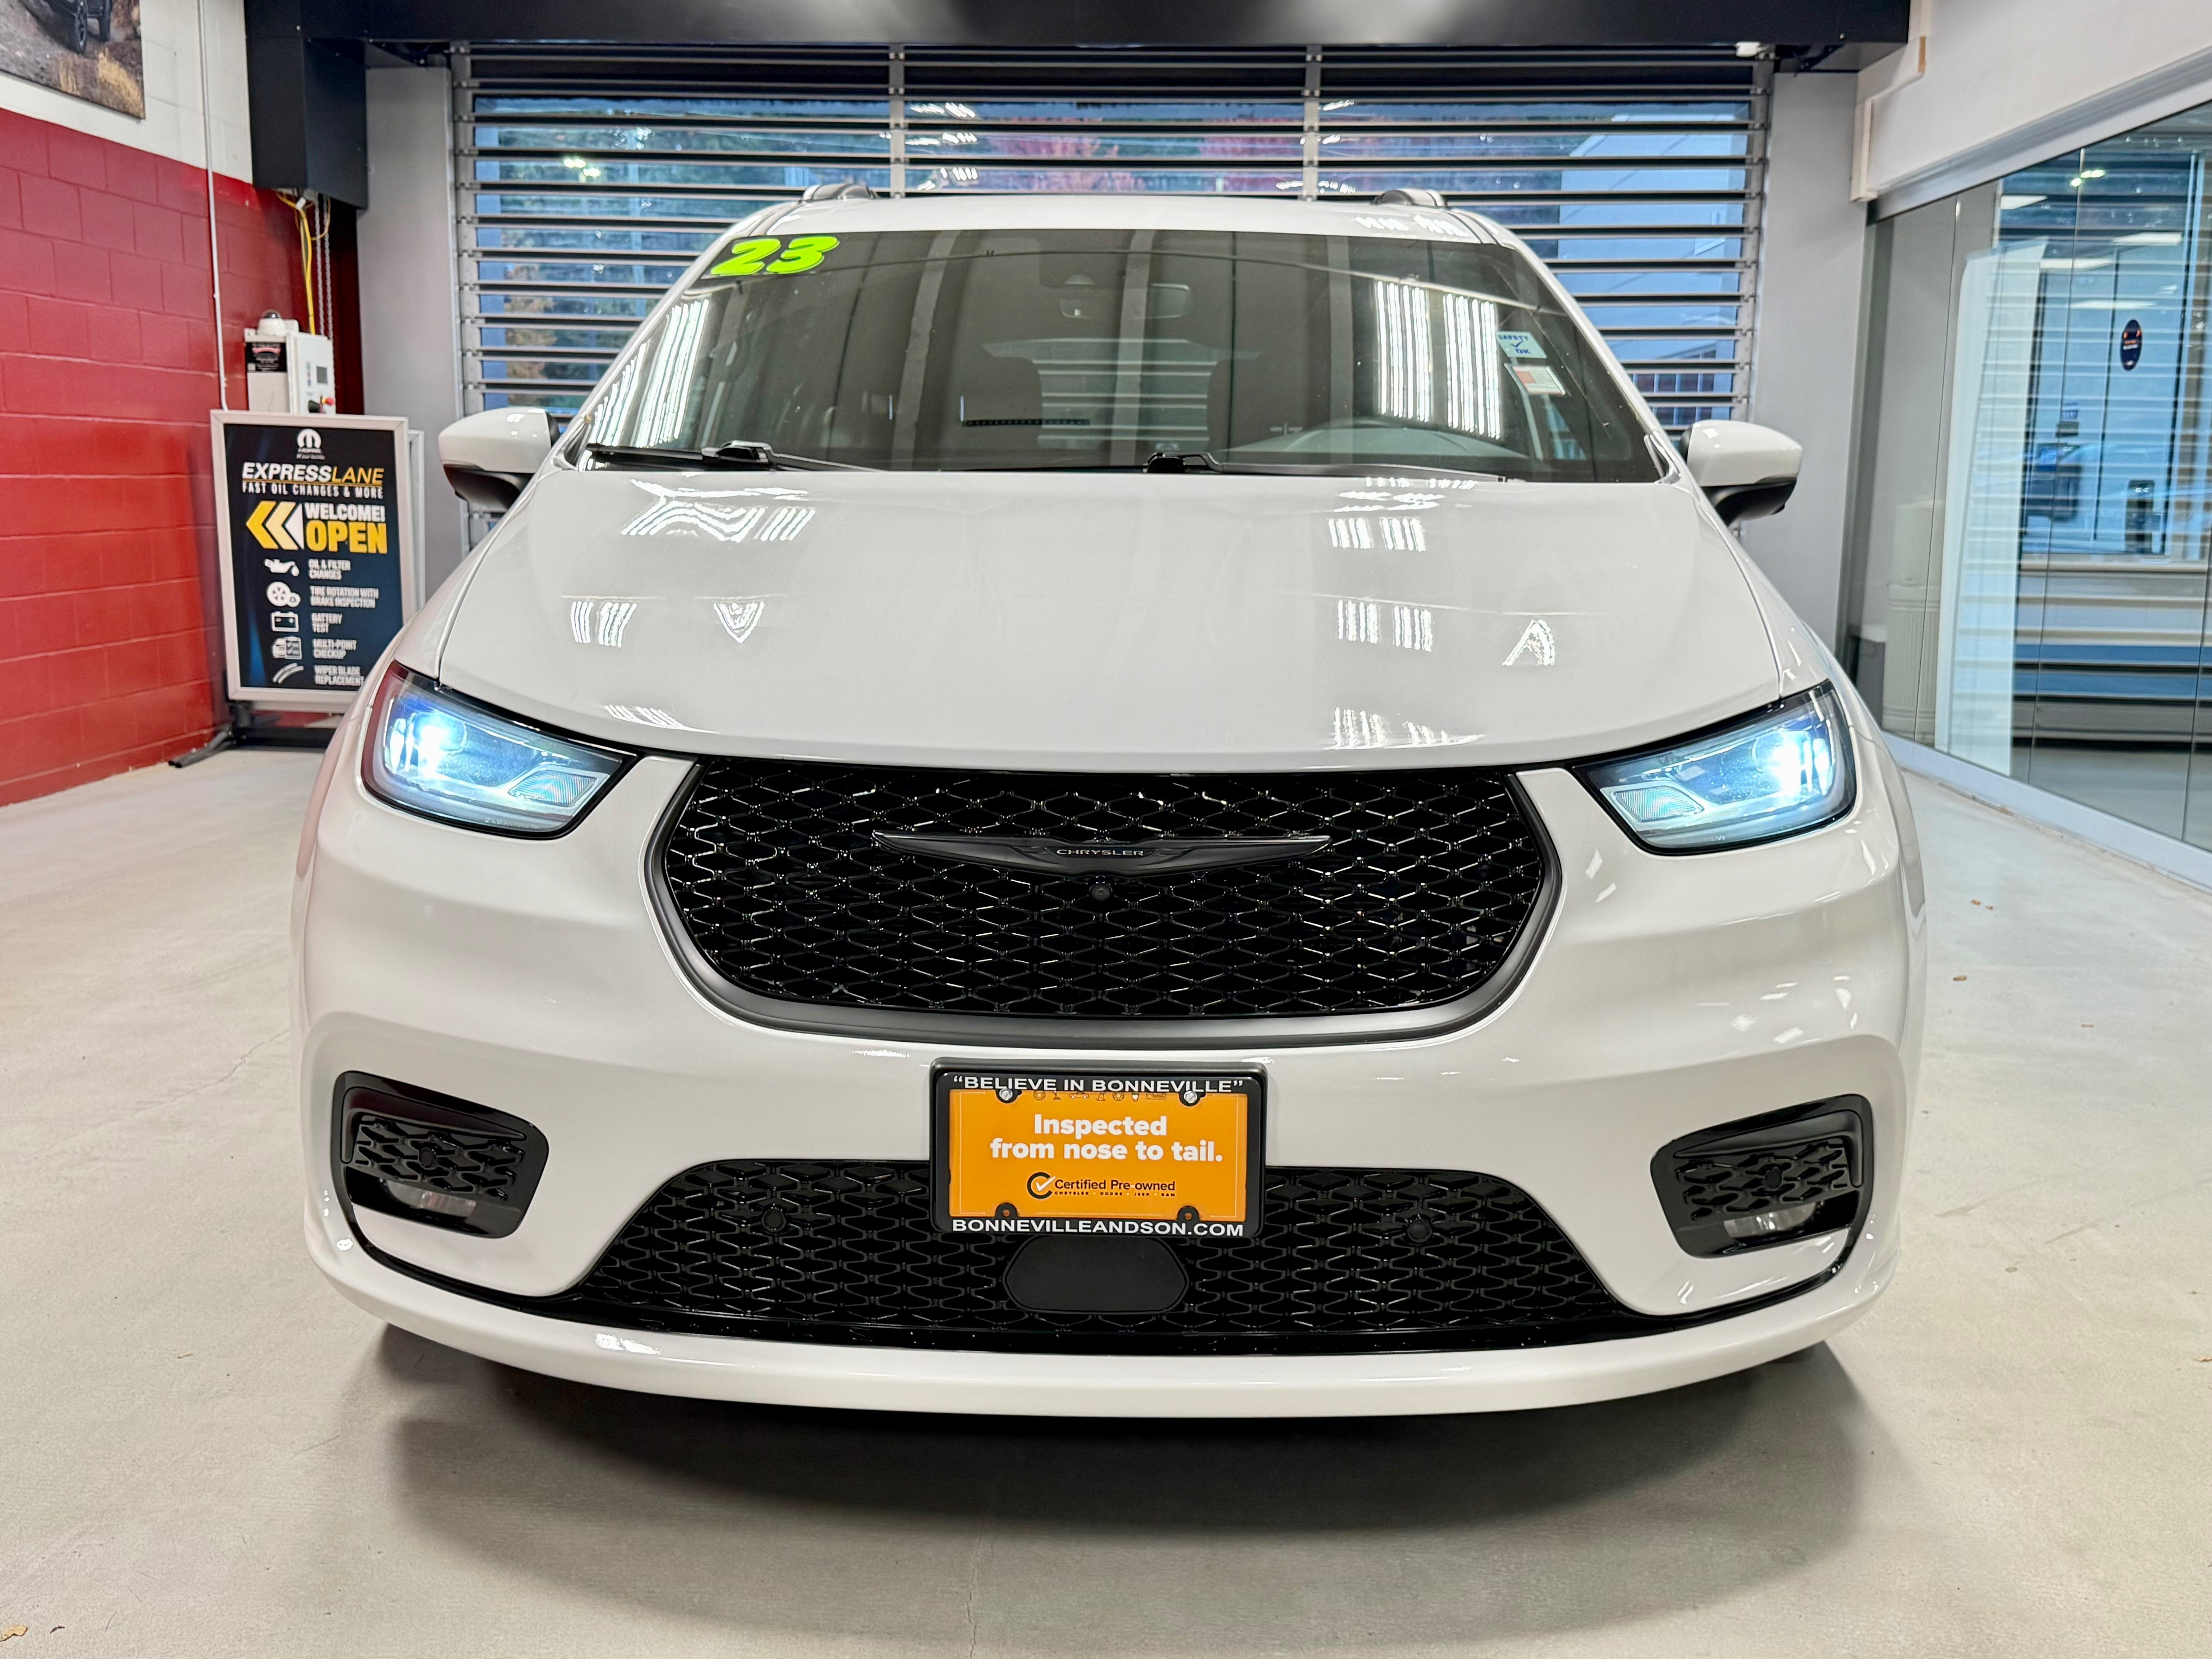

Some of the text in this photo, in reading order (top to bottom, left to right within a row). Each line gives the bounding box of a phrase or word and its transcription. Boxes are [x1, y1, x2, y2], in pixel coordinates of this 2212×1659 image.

[710, 236, 840, 276] 23
[242, 481, 383, 499] FAST OIL CHANGES & MORE
[305, 503, 386, 522] WELCOME!
[306, 520, 387, 555] OPEN
[309, 559, 351, 571] OIL & FILTER
[309, 570, 342, 580] CHANGES
[310, 586, 379, 599] TIRE ROTATION WITH
[311, 596, 376, 608] BRAKE INSPECTION
[311, 613, 342, 624] BATTERY
[312, 623, 329, 634] TEST
[313, 639, 357, 651] MULTI-POINT
[314, 649, 346, 659] CHECKUP
[314, 665, 361, 676] WIPER BLADE
[315, 675, 364, 687] REPLACEMENT
[1064, 1079, 1084, 1091] IN
[1034, 1114, 1167, 1139] Inspected
[990, 1137, 1223, 1162] from nose to tail.
[1055, 1179, 1106, 1190] Certified
[952, 1219, 1243, 1236] BONNEVILLEANDSON.COM
